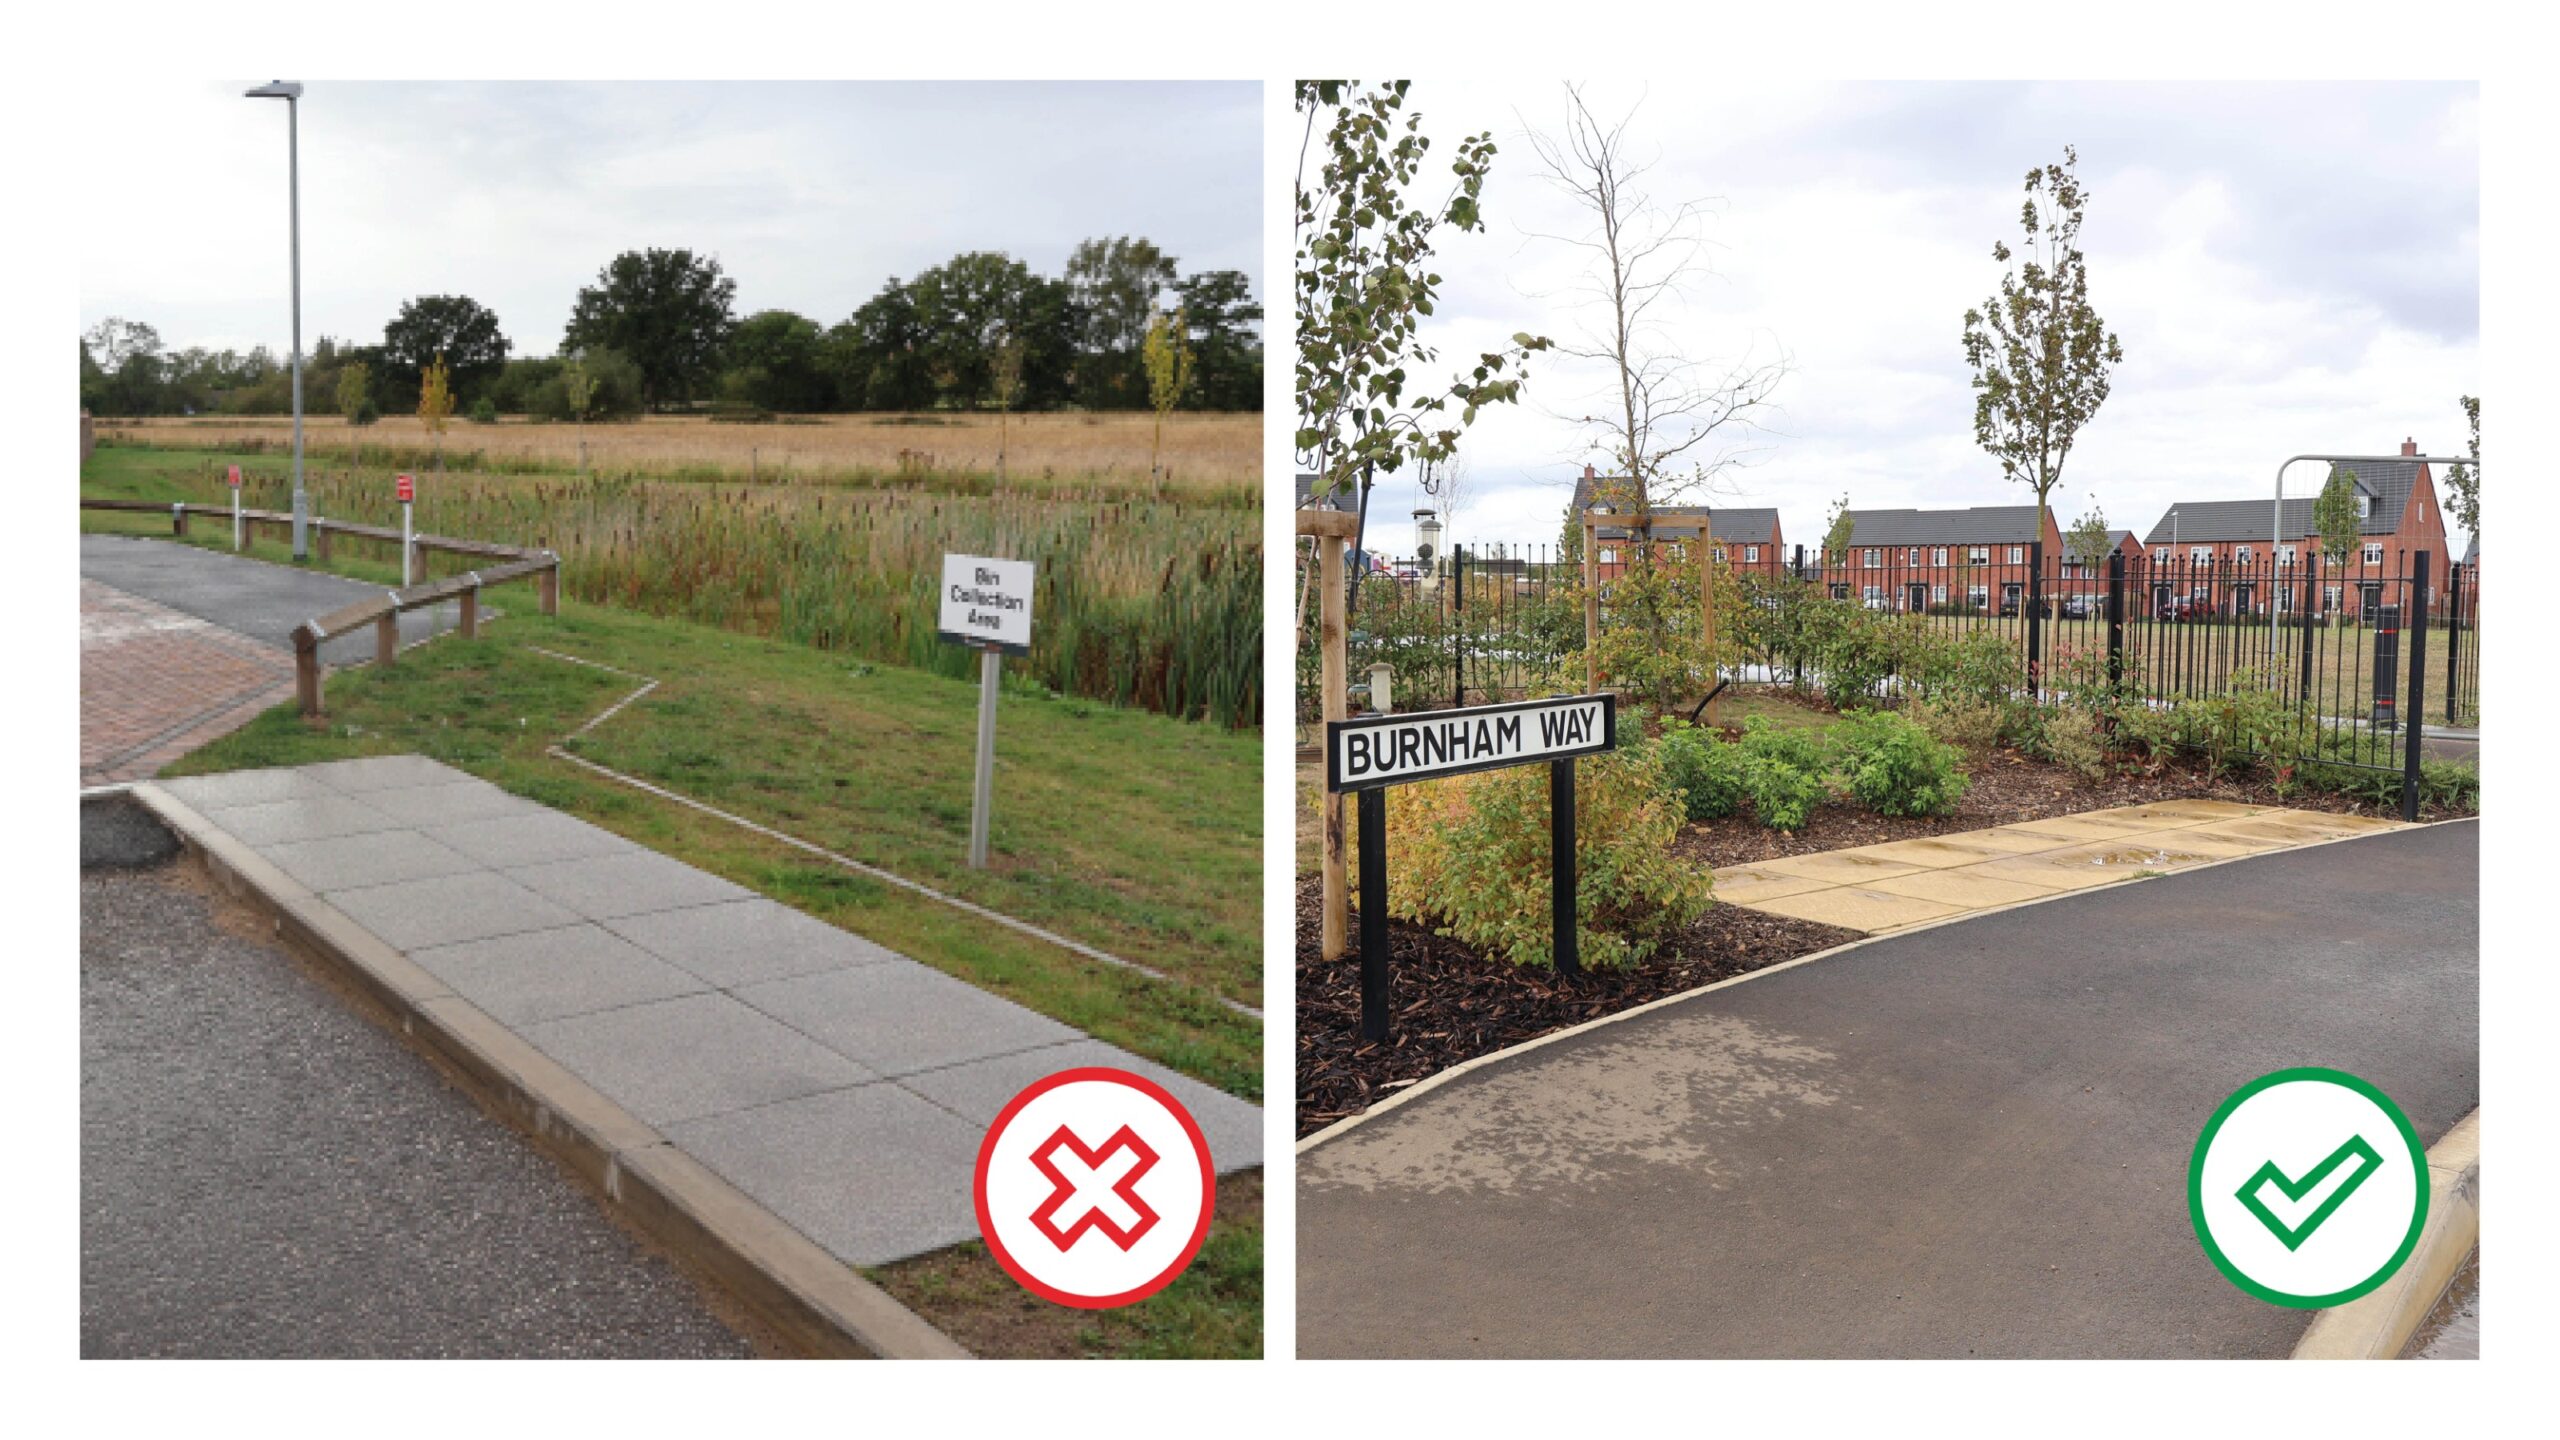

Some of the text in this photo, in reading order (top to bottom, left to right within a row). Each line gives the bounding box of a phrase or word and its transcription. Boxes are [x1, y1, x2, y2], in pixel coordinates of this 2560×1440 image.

[975, 567, 1000, 586] Bin
[950, 585, 1024, 612] Collection
[967, 609, 1000, 630] Area
[1347, 706, 1596, 776] BURNHAM WAY
